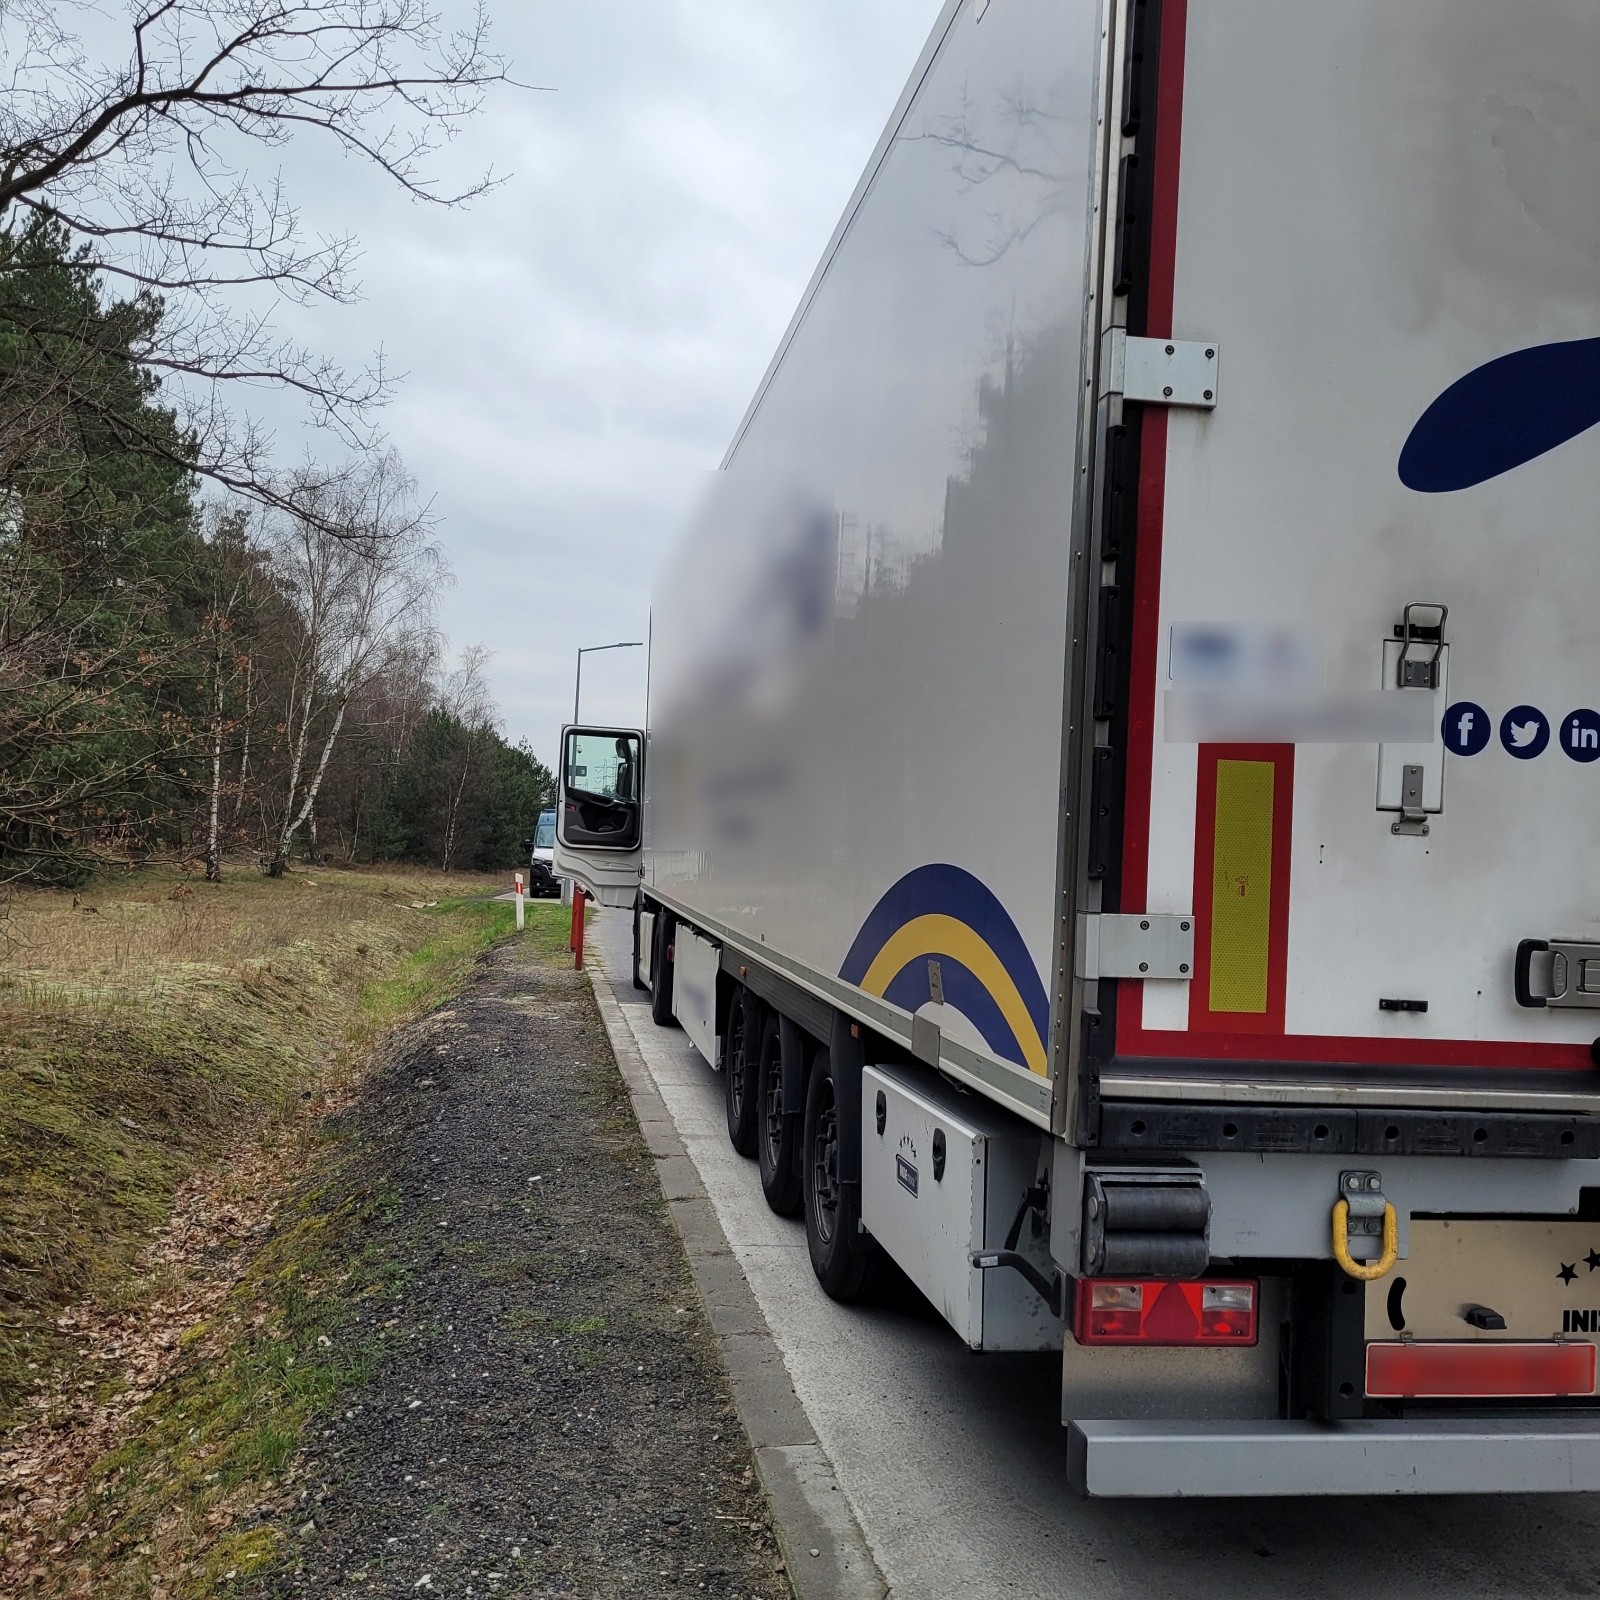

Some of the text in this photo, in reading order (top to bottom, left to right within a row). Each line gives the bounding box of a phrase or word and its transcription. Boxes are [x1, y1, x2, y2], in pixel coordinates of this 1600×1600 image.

[1457, 712, 1474, 746] f
[1571, 718, 1598, 749] in
[1562, 1309, 1600, 1333] INI
